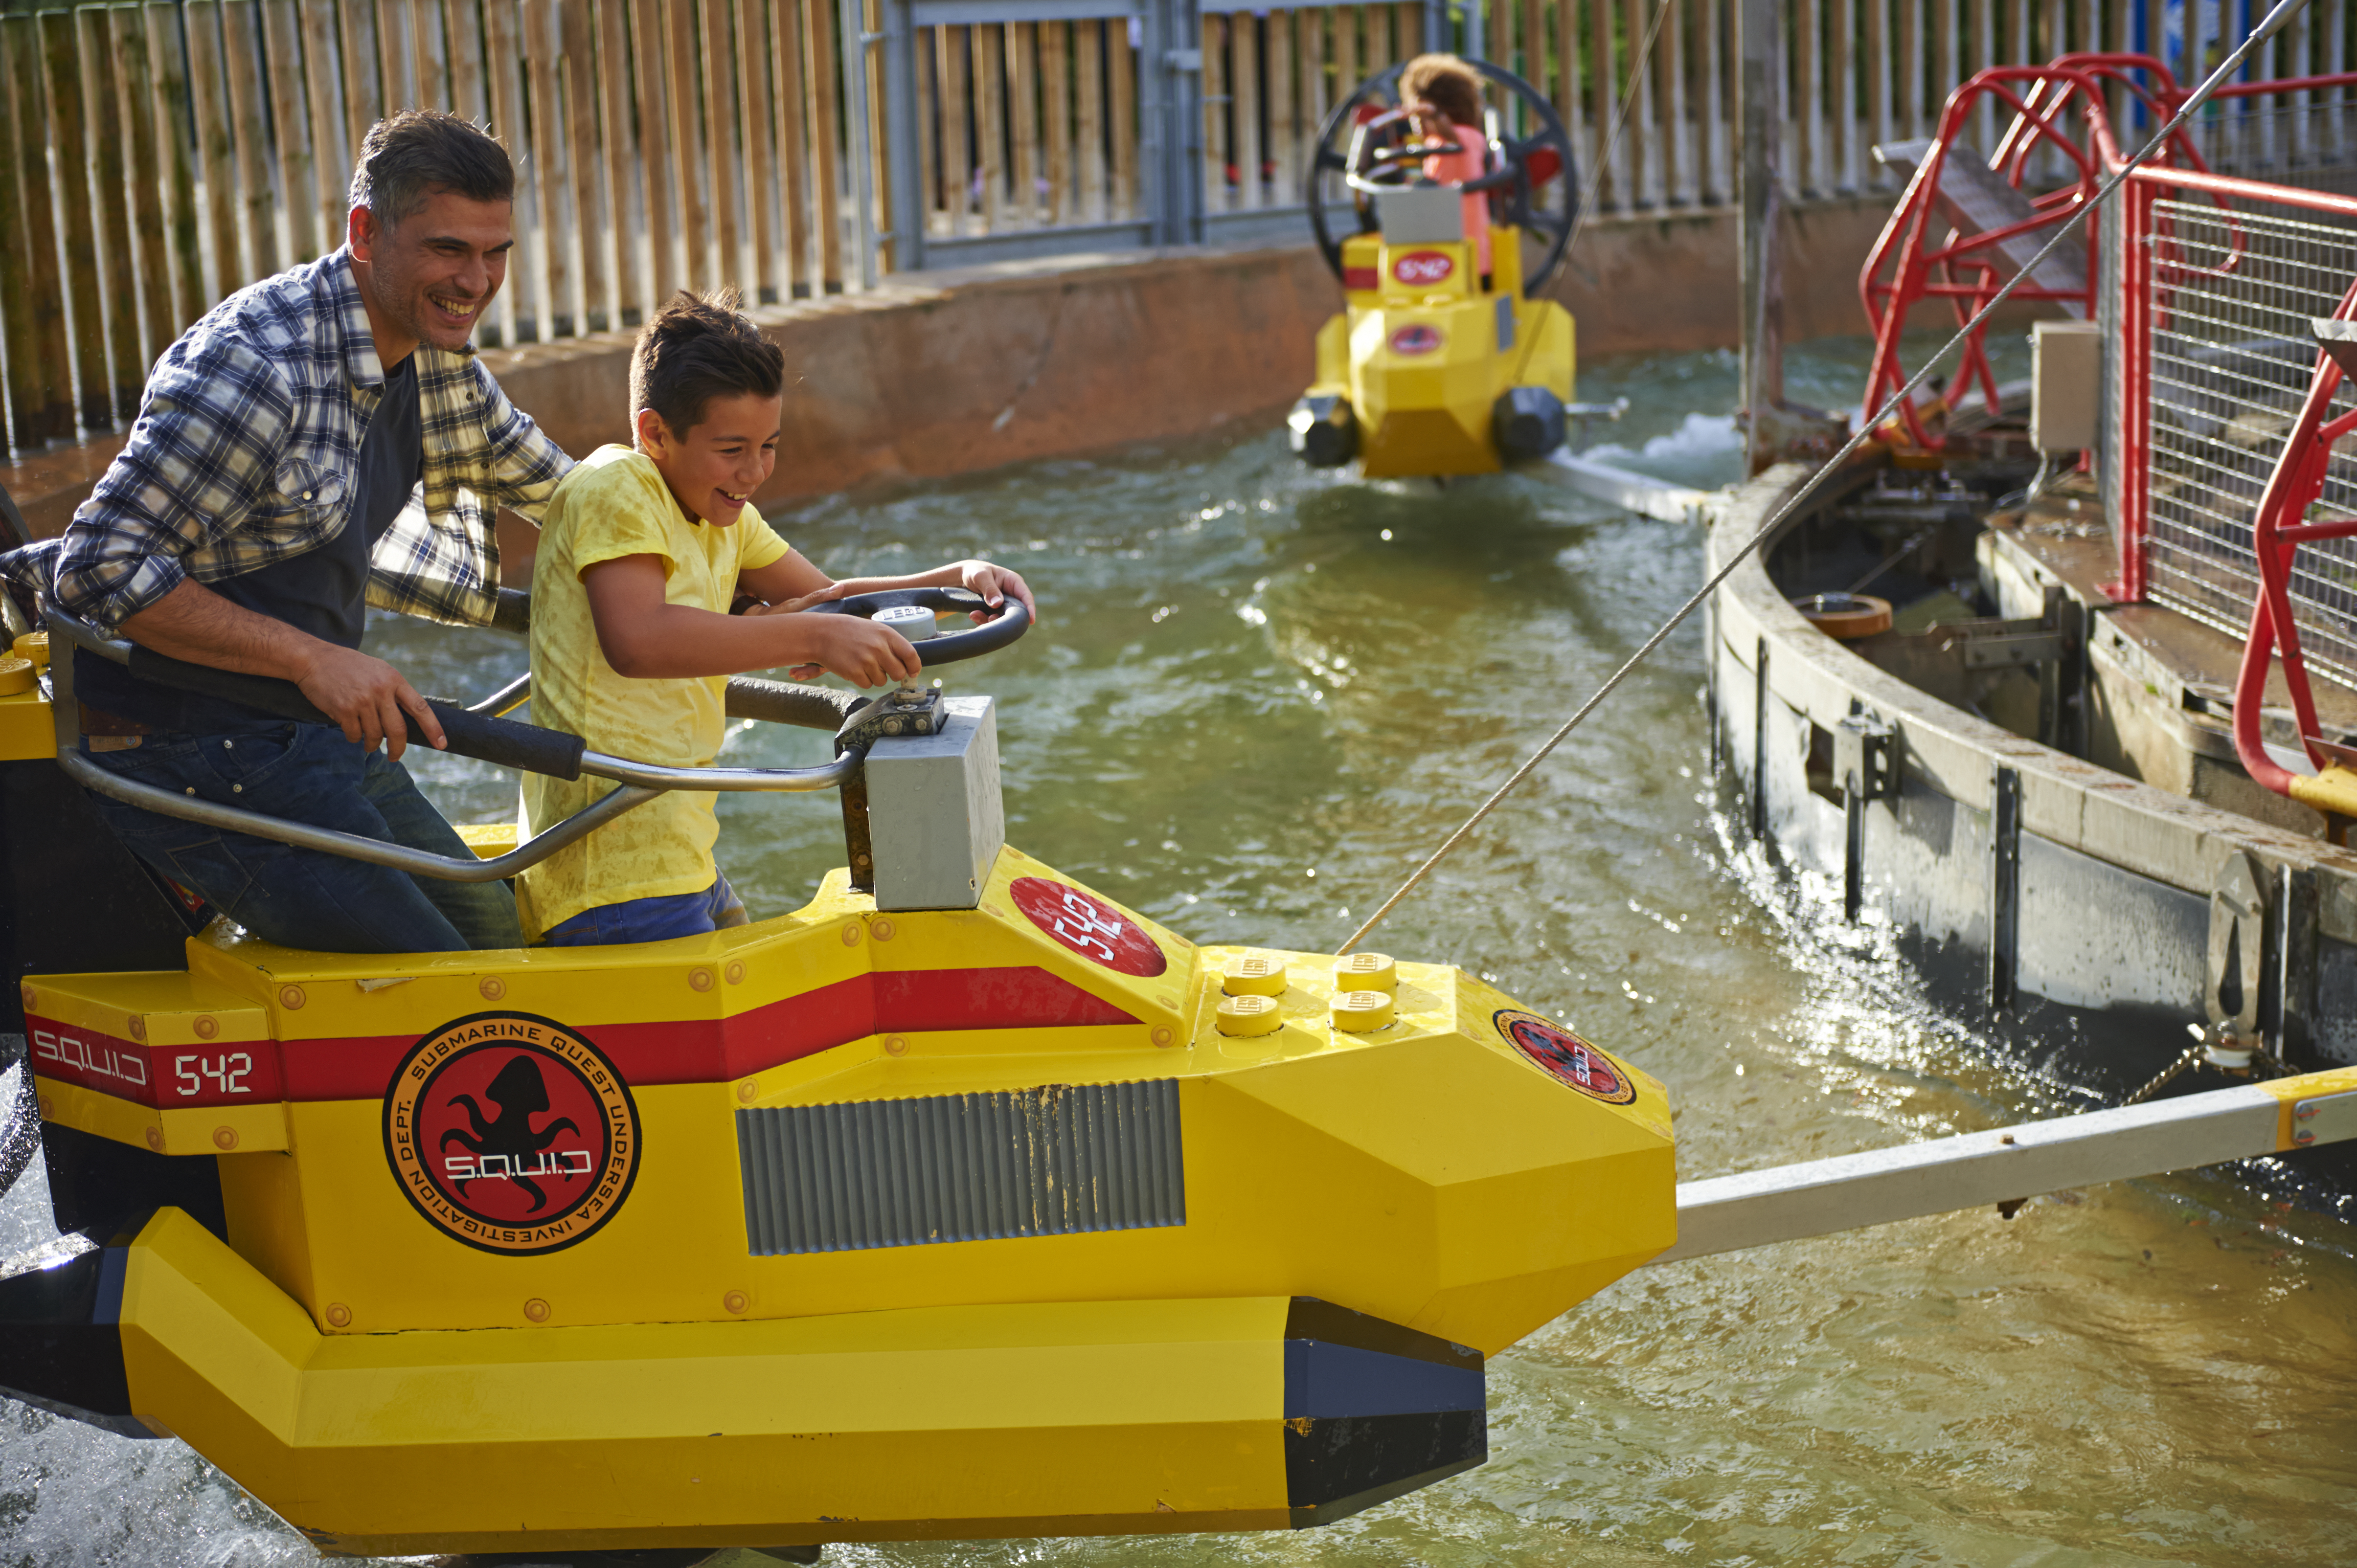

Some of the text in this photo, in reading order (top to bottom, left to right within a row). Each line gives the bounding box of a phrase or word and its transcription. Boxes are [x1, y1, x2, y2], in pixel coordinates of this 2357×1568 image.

[881, 606, 925, 620] LEGO
[1055, 894, 1122, 961] 542
[1242, 959, 1267, 975] LEGO
[1352, 955, 1376, 970] LEGO
[1235, 997, 1260, 1012] LEGO
[1348, 992, 1374, 1008] LEGO
[34, 1030, 146, 1085] S.Q.U.I.D
[176, 1053, 252, 1096] 542
[396, 1024, 627, 1243] SUBMARINE QUEST UNDERSEA INVESTIGATION DEPT.
[445, 1150, 591, 1180] S.Q.U.I.D
